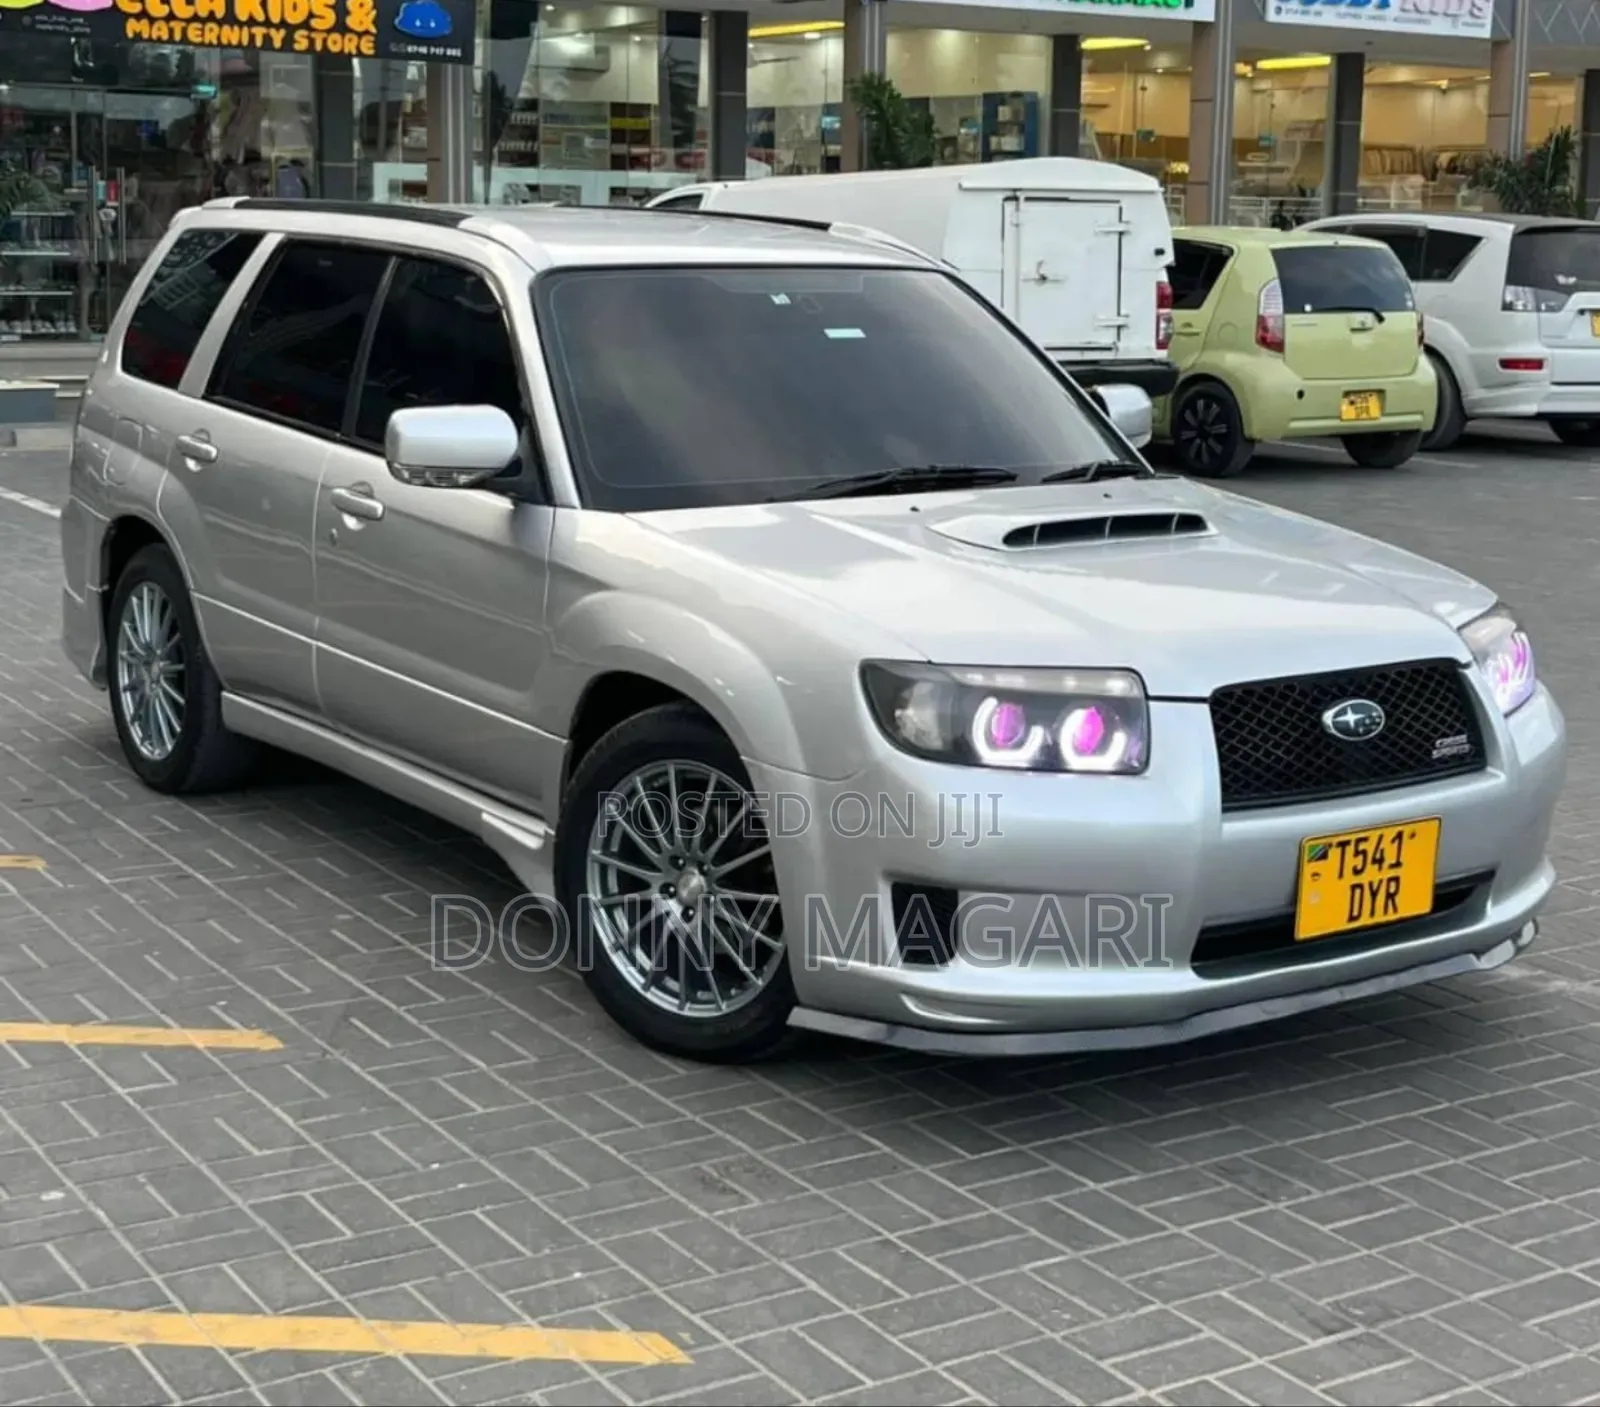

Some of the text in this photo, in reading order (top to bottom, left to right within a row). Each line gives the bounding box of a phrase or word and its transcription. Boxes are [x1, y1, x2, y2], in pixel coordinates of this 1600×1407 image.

[125, 18, 375, 55] MATERNITY STORE
[234, 0, 337, 30] KIDS
[345, 0, 377, 34] &
[1335, 830, 1404, 880] T541
[1347, 876, 1400, 923] DYR
